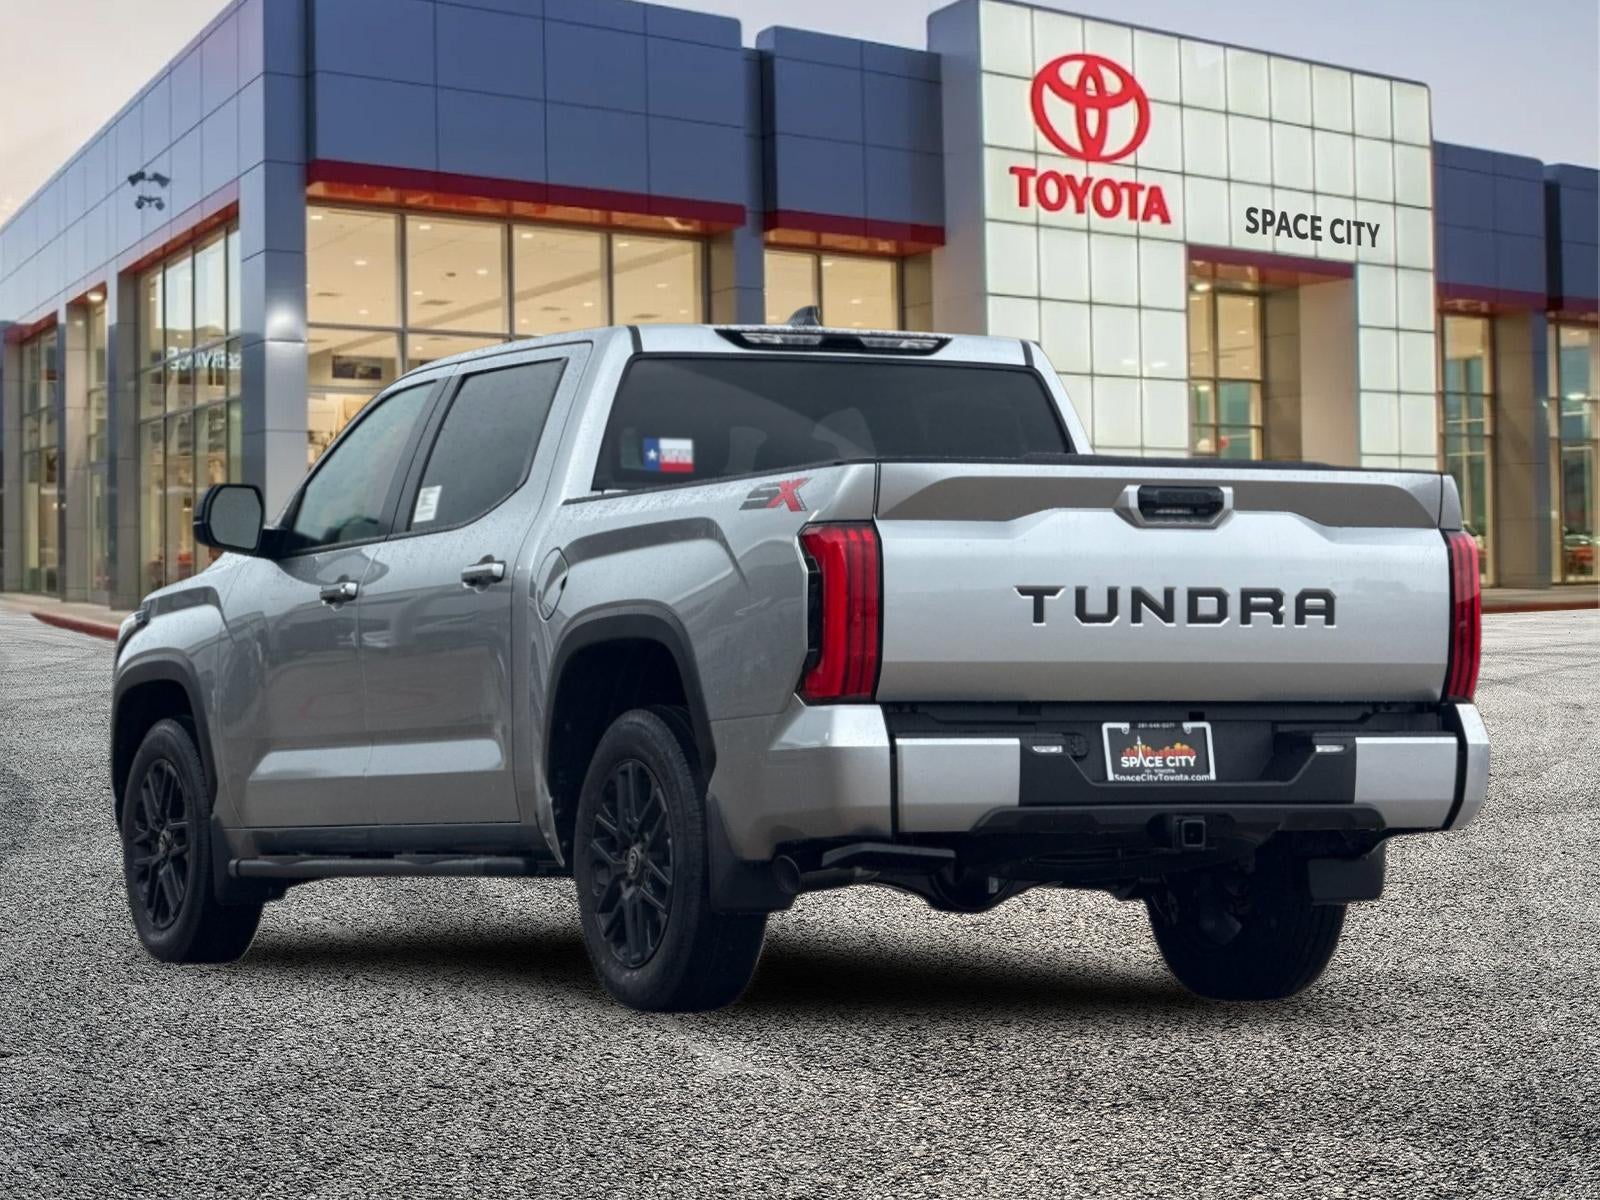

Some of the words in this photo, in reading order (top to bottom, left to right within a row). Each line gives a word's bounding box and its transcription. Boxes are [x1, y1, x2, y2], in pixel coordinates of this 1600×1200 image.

[1009, 166, 1172, 225] TOYOTA
[1245, 206, 1323, 242] SPACE
[1329, 218, 1381, 248] CITY
[1013, 585, 1337, 628] TUNDRA
[1114, 773, 1210, 781] SpaceCityToyota.com
[1120, 755, 1164, 768] SPACE
[1166, 755, 1197, 767] CITY
